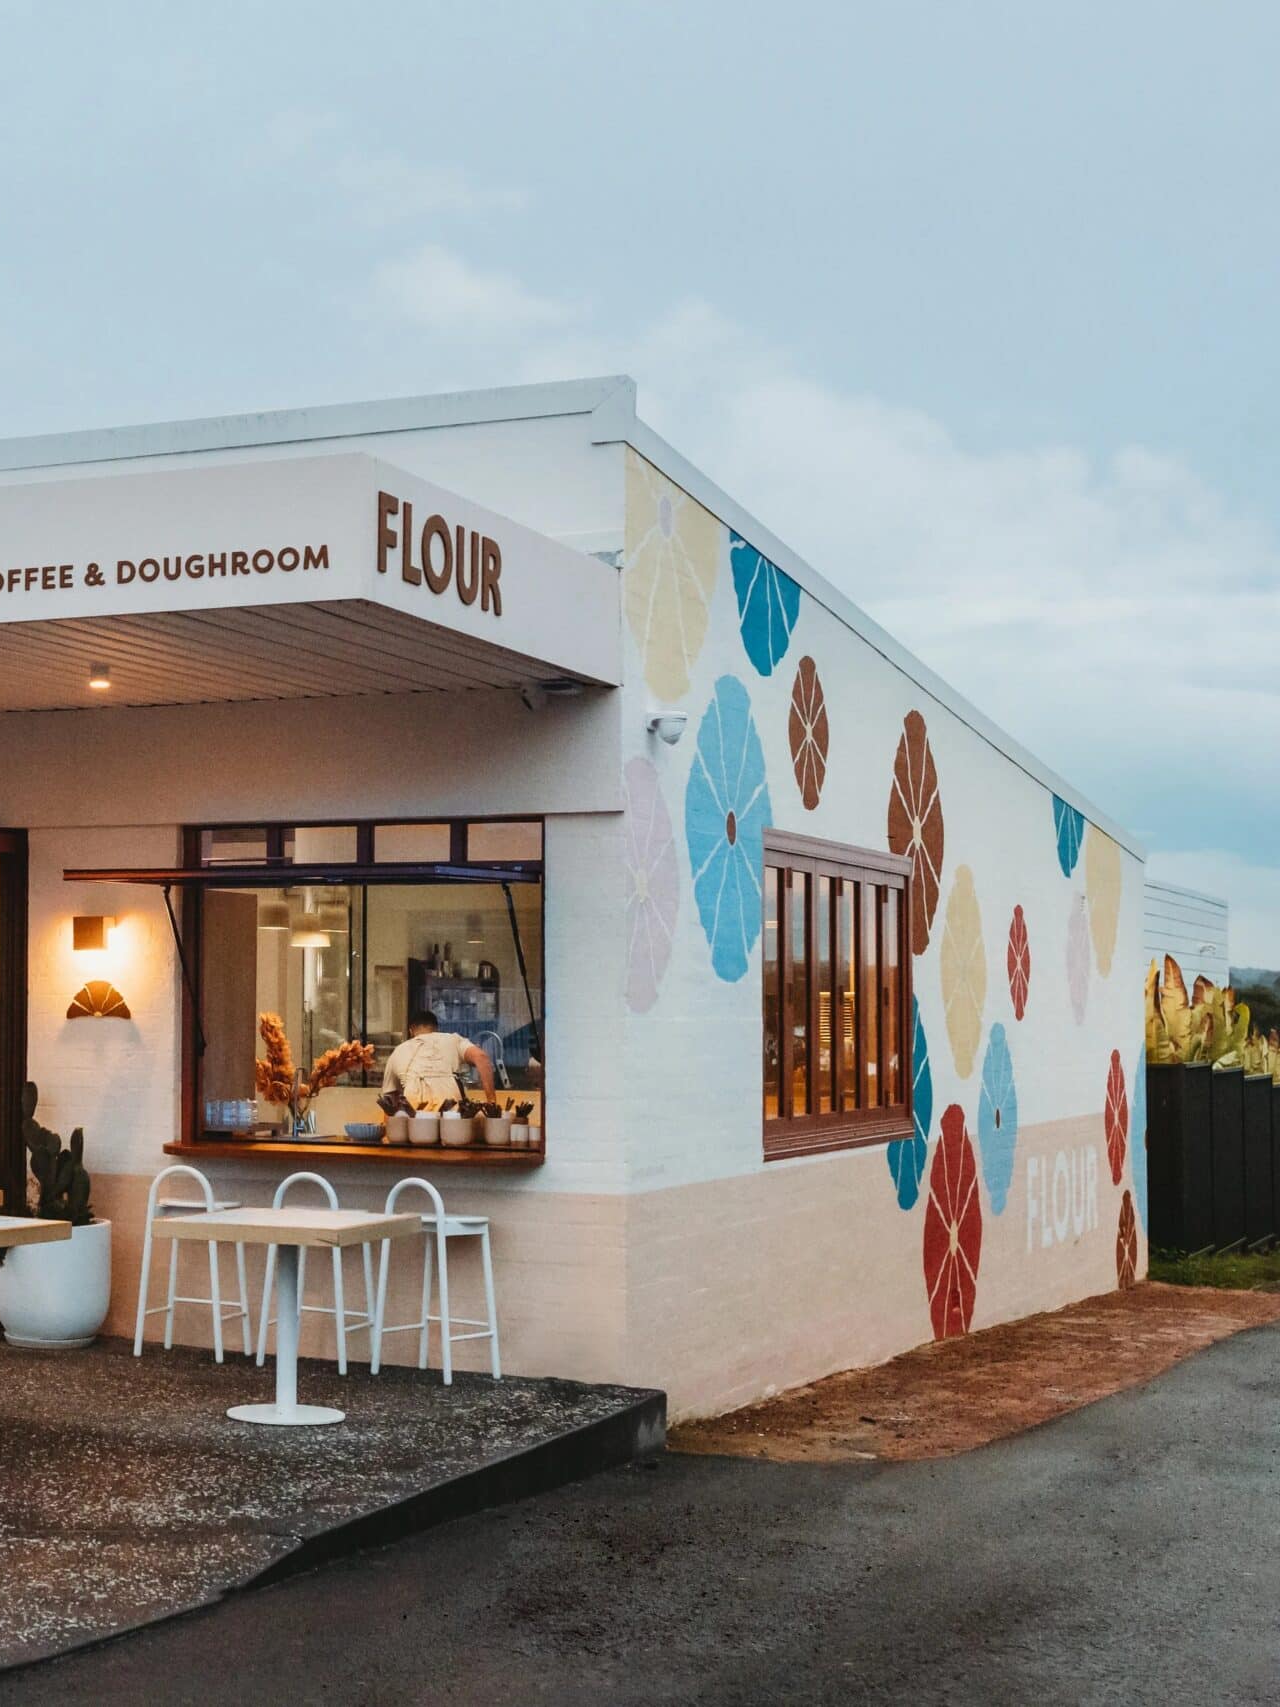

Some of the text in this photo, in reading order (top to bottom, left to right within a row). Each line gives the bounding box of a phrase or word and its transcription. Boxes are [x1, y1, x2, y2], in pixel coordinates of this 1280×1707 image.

[84, 562, 106, 587] &
[117, 544, 329, 585] DOUGHROOM
[377, 490, 503, 617] FLOUR
[1026, 1145, 1099, 1253] FLOUR
